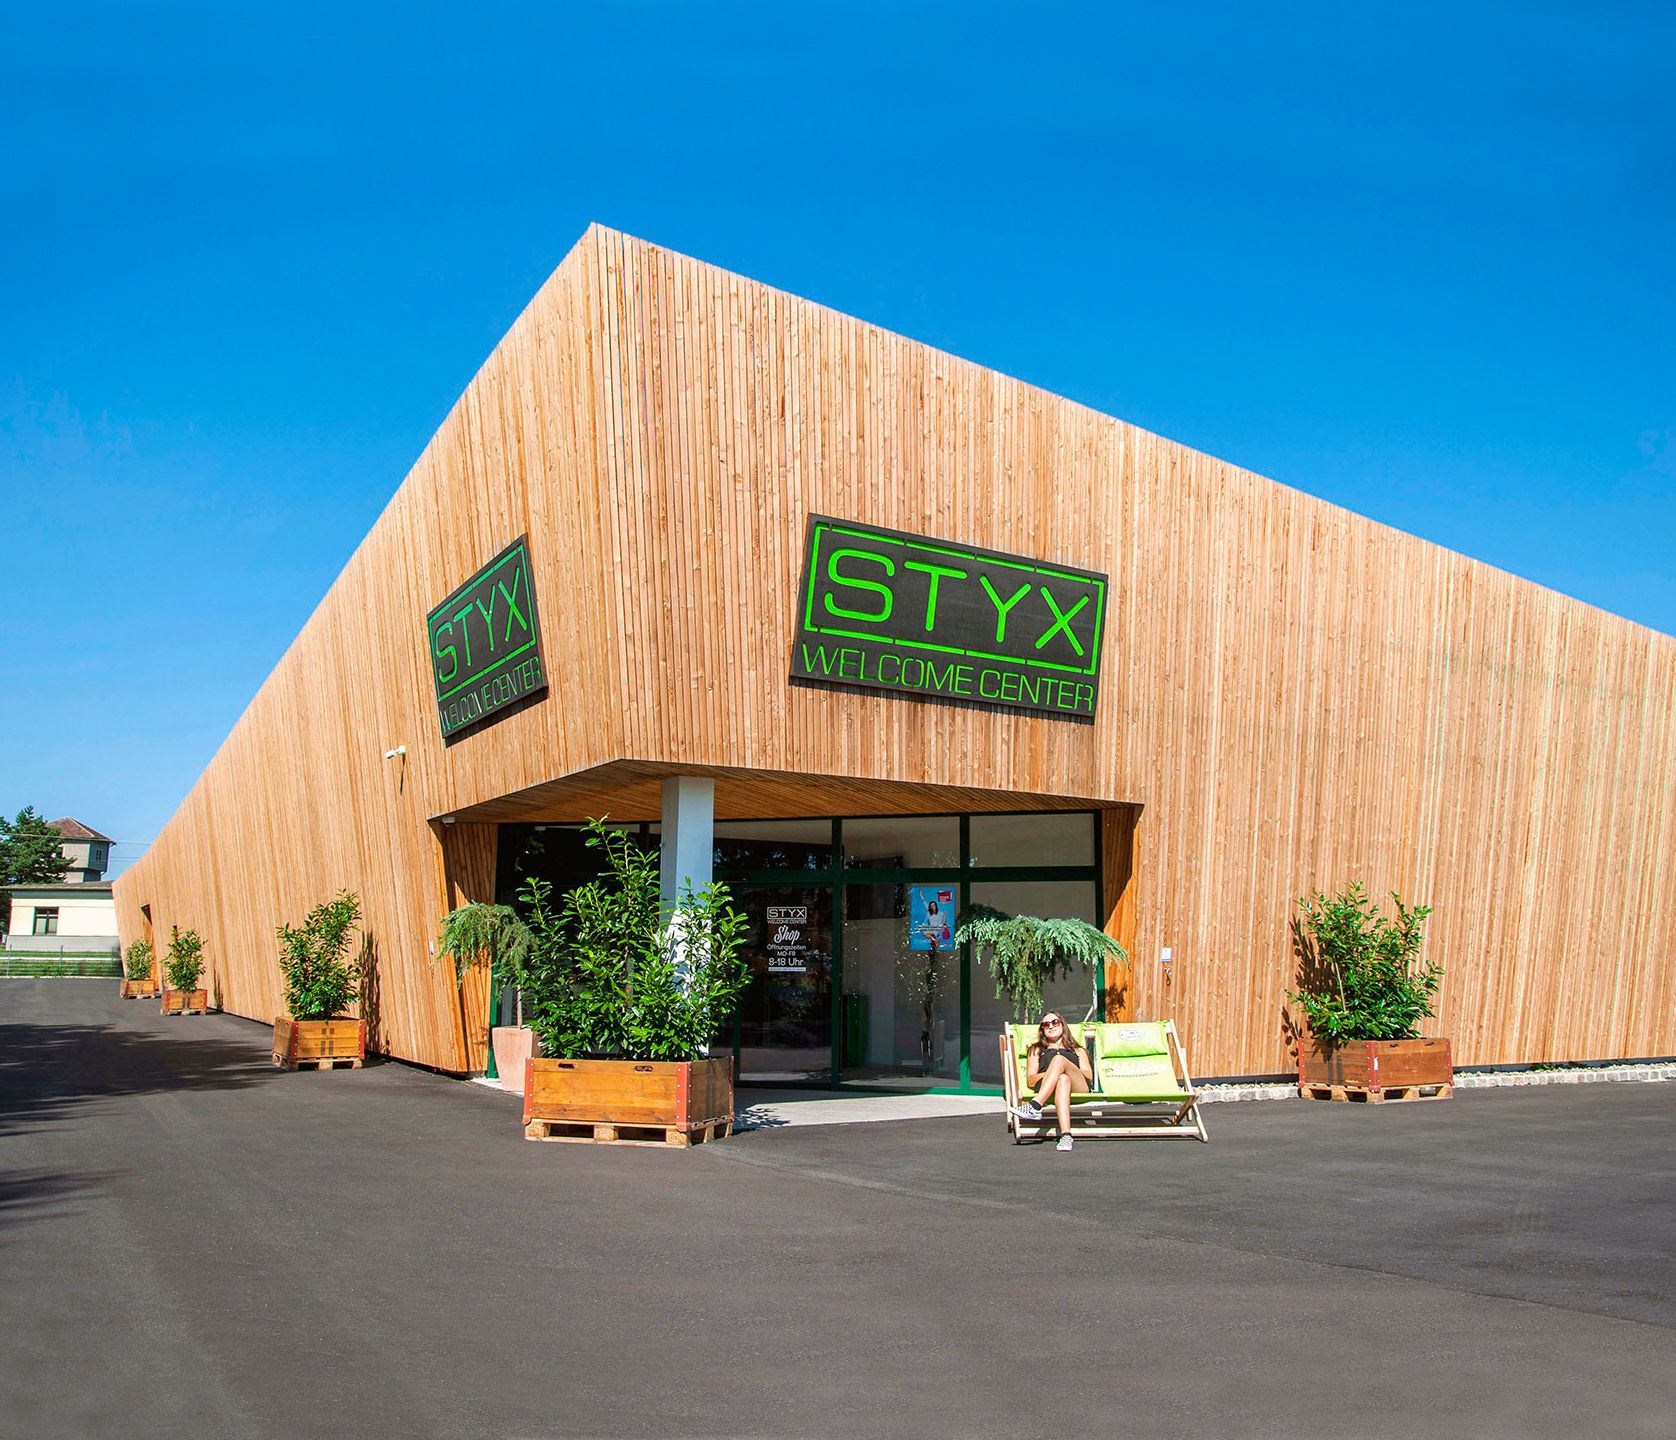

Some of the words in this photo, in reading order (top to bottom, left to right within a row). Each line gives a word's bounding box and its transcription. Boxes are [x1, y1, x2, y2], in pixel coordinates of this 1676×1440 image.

[434, 565, 527, 683] STYX
[824, 548, 1090, 656] STYX
[492, 656, 542, 705] CENTER
[802, 643, 973, 695] WELCOME
[979, 669, 1095, 712] CENTER
[769, 908, 805, 918] STYX
[773, 925, 800, 945] Shop
[768, 957, 786, 966] 8-18
[788, 957, 803, 966] Uhr
